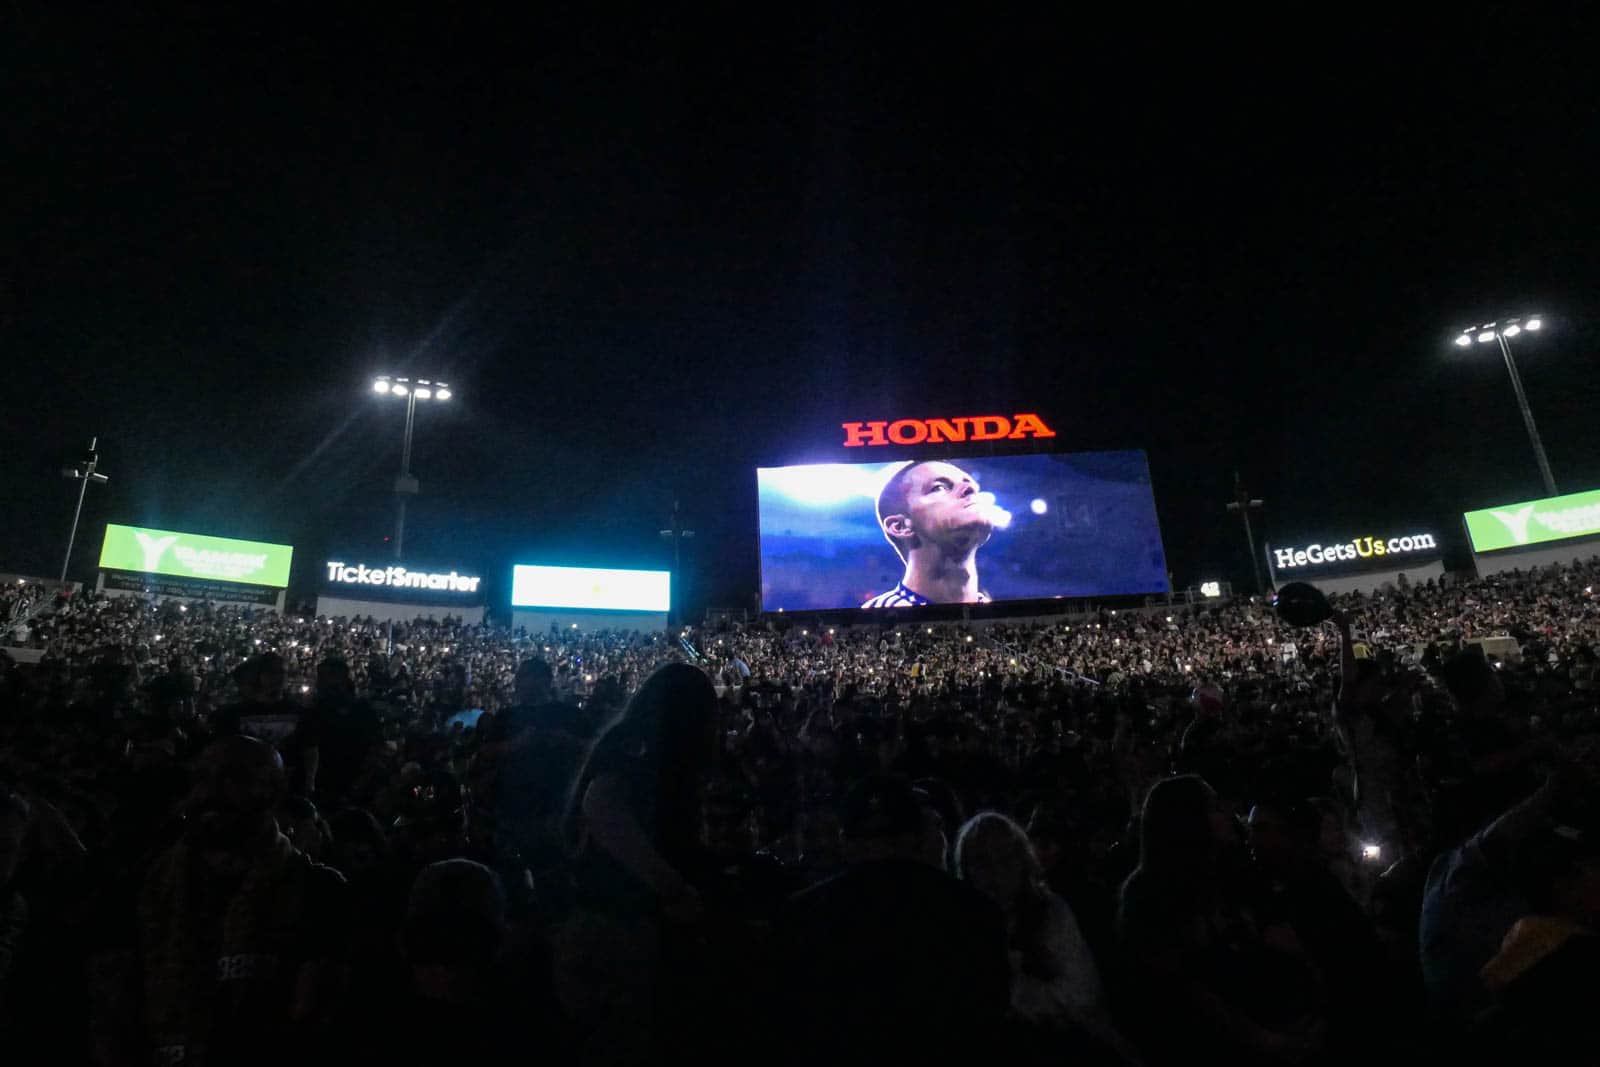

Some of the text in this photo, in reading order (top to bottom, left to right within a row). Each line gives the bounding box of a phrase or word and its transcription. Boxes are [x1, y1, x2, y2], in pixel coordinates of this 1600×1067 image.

[842, 413, 1056, 447] HONDA
[1273, 532, 1437, 569] HeGetsUs.com
[326, 560, 482, 593] TicketSmarter
